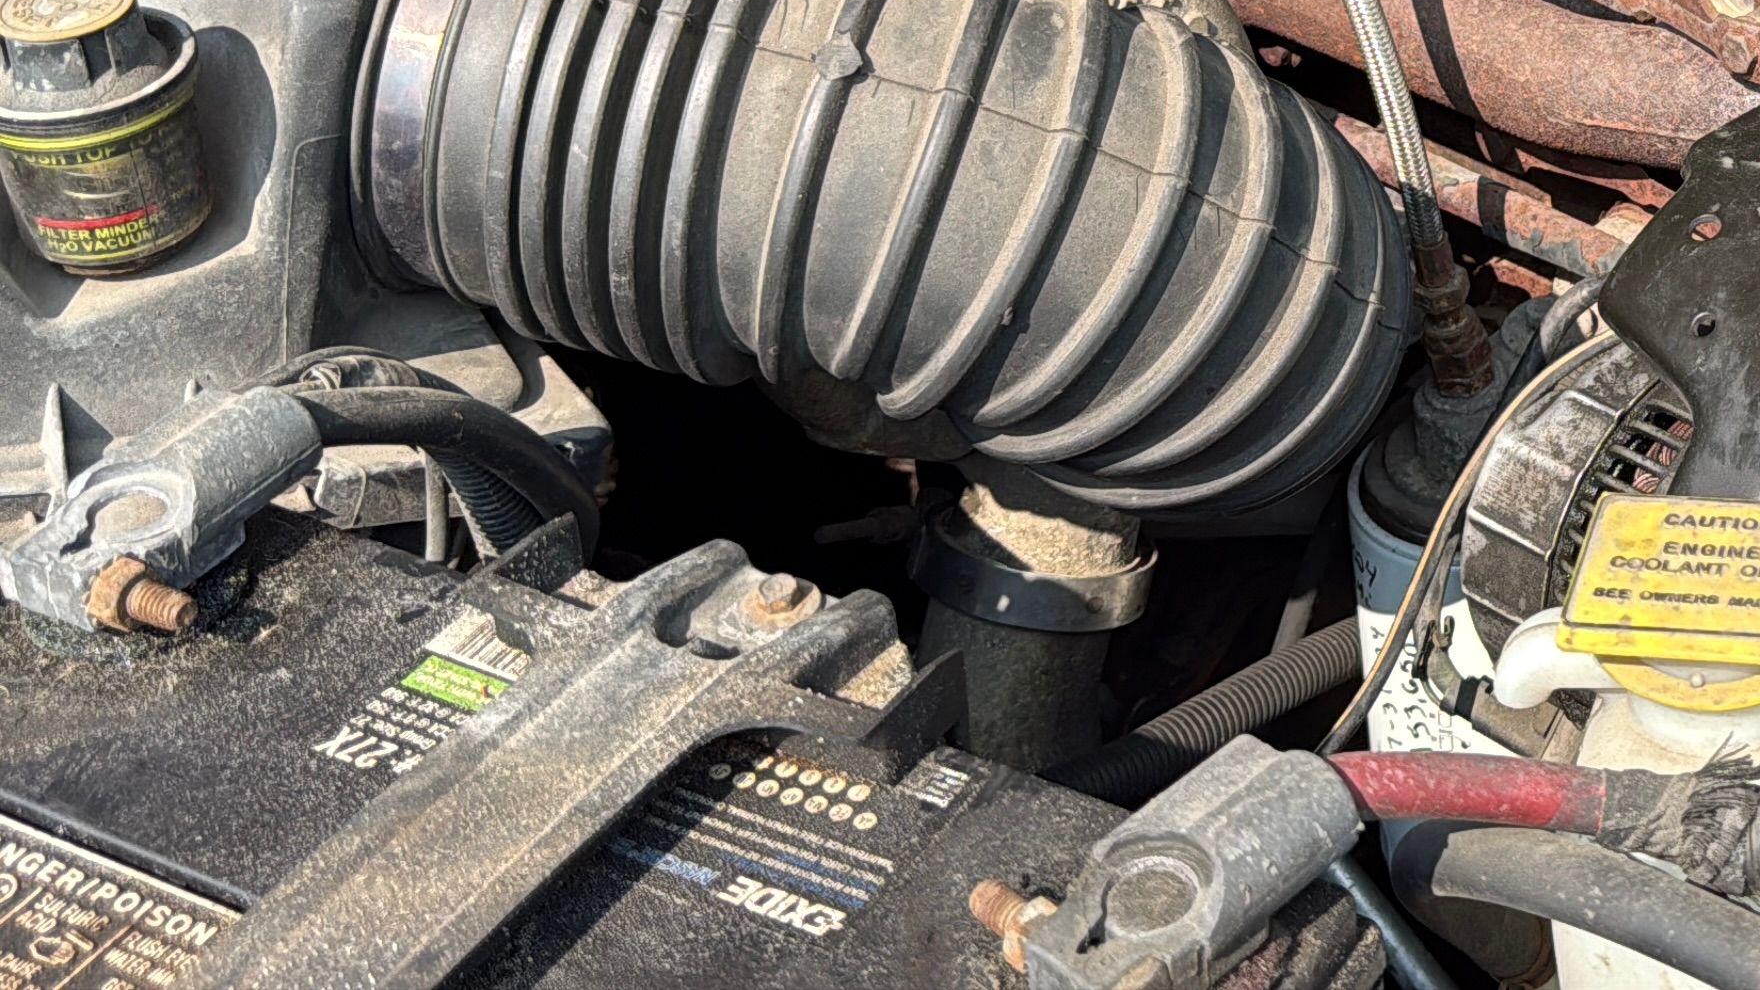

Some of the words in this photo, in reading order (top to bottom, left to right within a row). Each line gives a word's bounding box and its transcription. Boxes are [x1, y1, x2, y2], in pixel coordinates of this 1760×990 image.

[36, 224, 91, 242] FILTER
[96, 213, 161, 238] MINDER
[48, 236, 79, 254] H2O
[81, 228, 157, 252] VACUUM
[1609, 555, 1729, 577] COOLANT
[1593, 586, 1632, 600] SEE
[1639, 590, 1720, 606] OWNERS
[311, 728, 378, 772] 27X
[34, 892, 111, 932] SULFURIC
[718, 874, 847, 937] EXIDE
[15, 910, 57, 933] ACID
[122, 931, 169, 958] FLUSH
[103, 948, 152, 977] WATER
